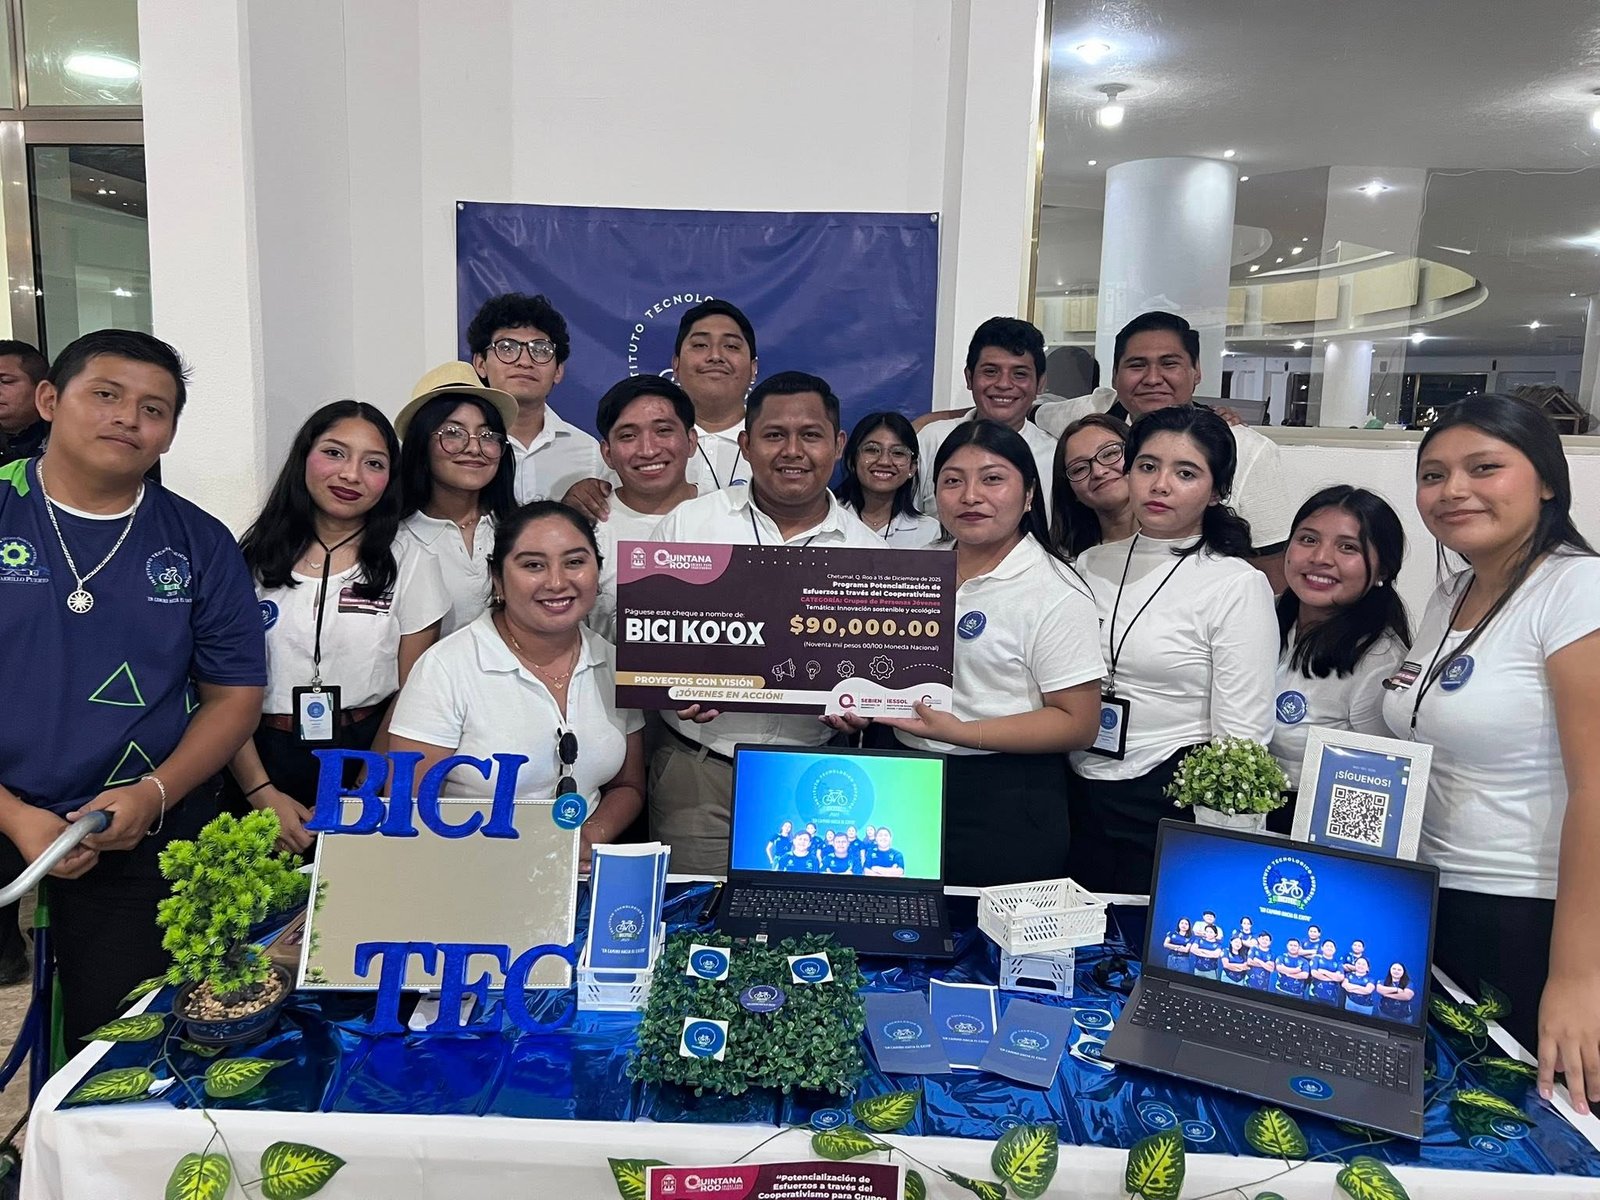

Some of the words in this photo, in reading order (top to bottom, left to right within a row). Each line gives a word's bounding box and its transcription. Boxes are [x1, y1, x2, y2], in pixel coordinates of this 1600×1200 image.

[628, 323, 645, 377] TITUTO
[653, 549, 712, 566] QUINTANA
[669, 562, 690, 570] ROO
[832, 581, 869, 589] Programa
[870, 582, 930, 590] Potencialización
[624, 608, 655, 616] Páguese
[672, 610, 699, 618] cheque
[790, 614, 940, 637] $90,000.00
[625, 618, 676, 642] BICI
[682, 620, 765, 645] KO'OX
[910, 644, 940, 652] Nacional)
[634, 676, 693, 685] PROYECTOS
[695, 677, 717, 686] CON
[719, 677, 754, 687] VISIÓN
[675, 689, 724, 698] ¡JÓVENES
[726, 690, 740, 698] EN
[742, 690, 784, 700] ACCIÓN!
[1335, 769, 1392, 788] ¡SÍGUENOS!
[304, 749, 528, 839] BICI
[354, 941, 576, 1034] TEC
[684, 1174, 743, 1189] QUINTANA
[858, 1175, 870, 1183] de
[700, 1184, 721, 1192] ROO
[773, 1183, 818, 1191] Esfuerzos
[827, 1183, 856, 1191] través
[858, 1184, 873, 1192] del
[758, 1190, 829, 1200] Cooperativismo
[831, 1192, 852, 1200] para
